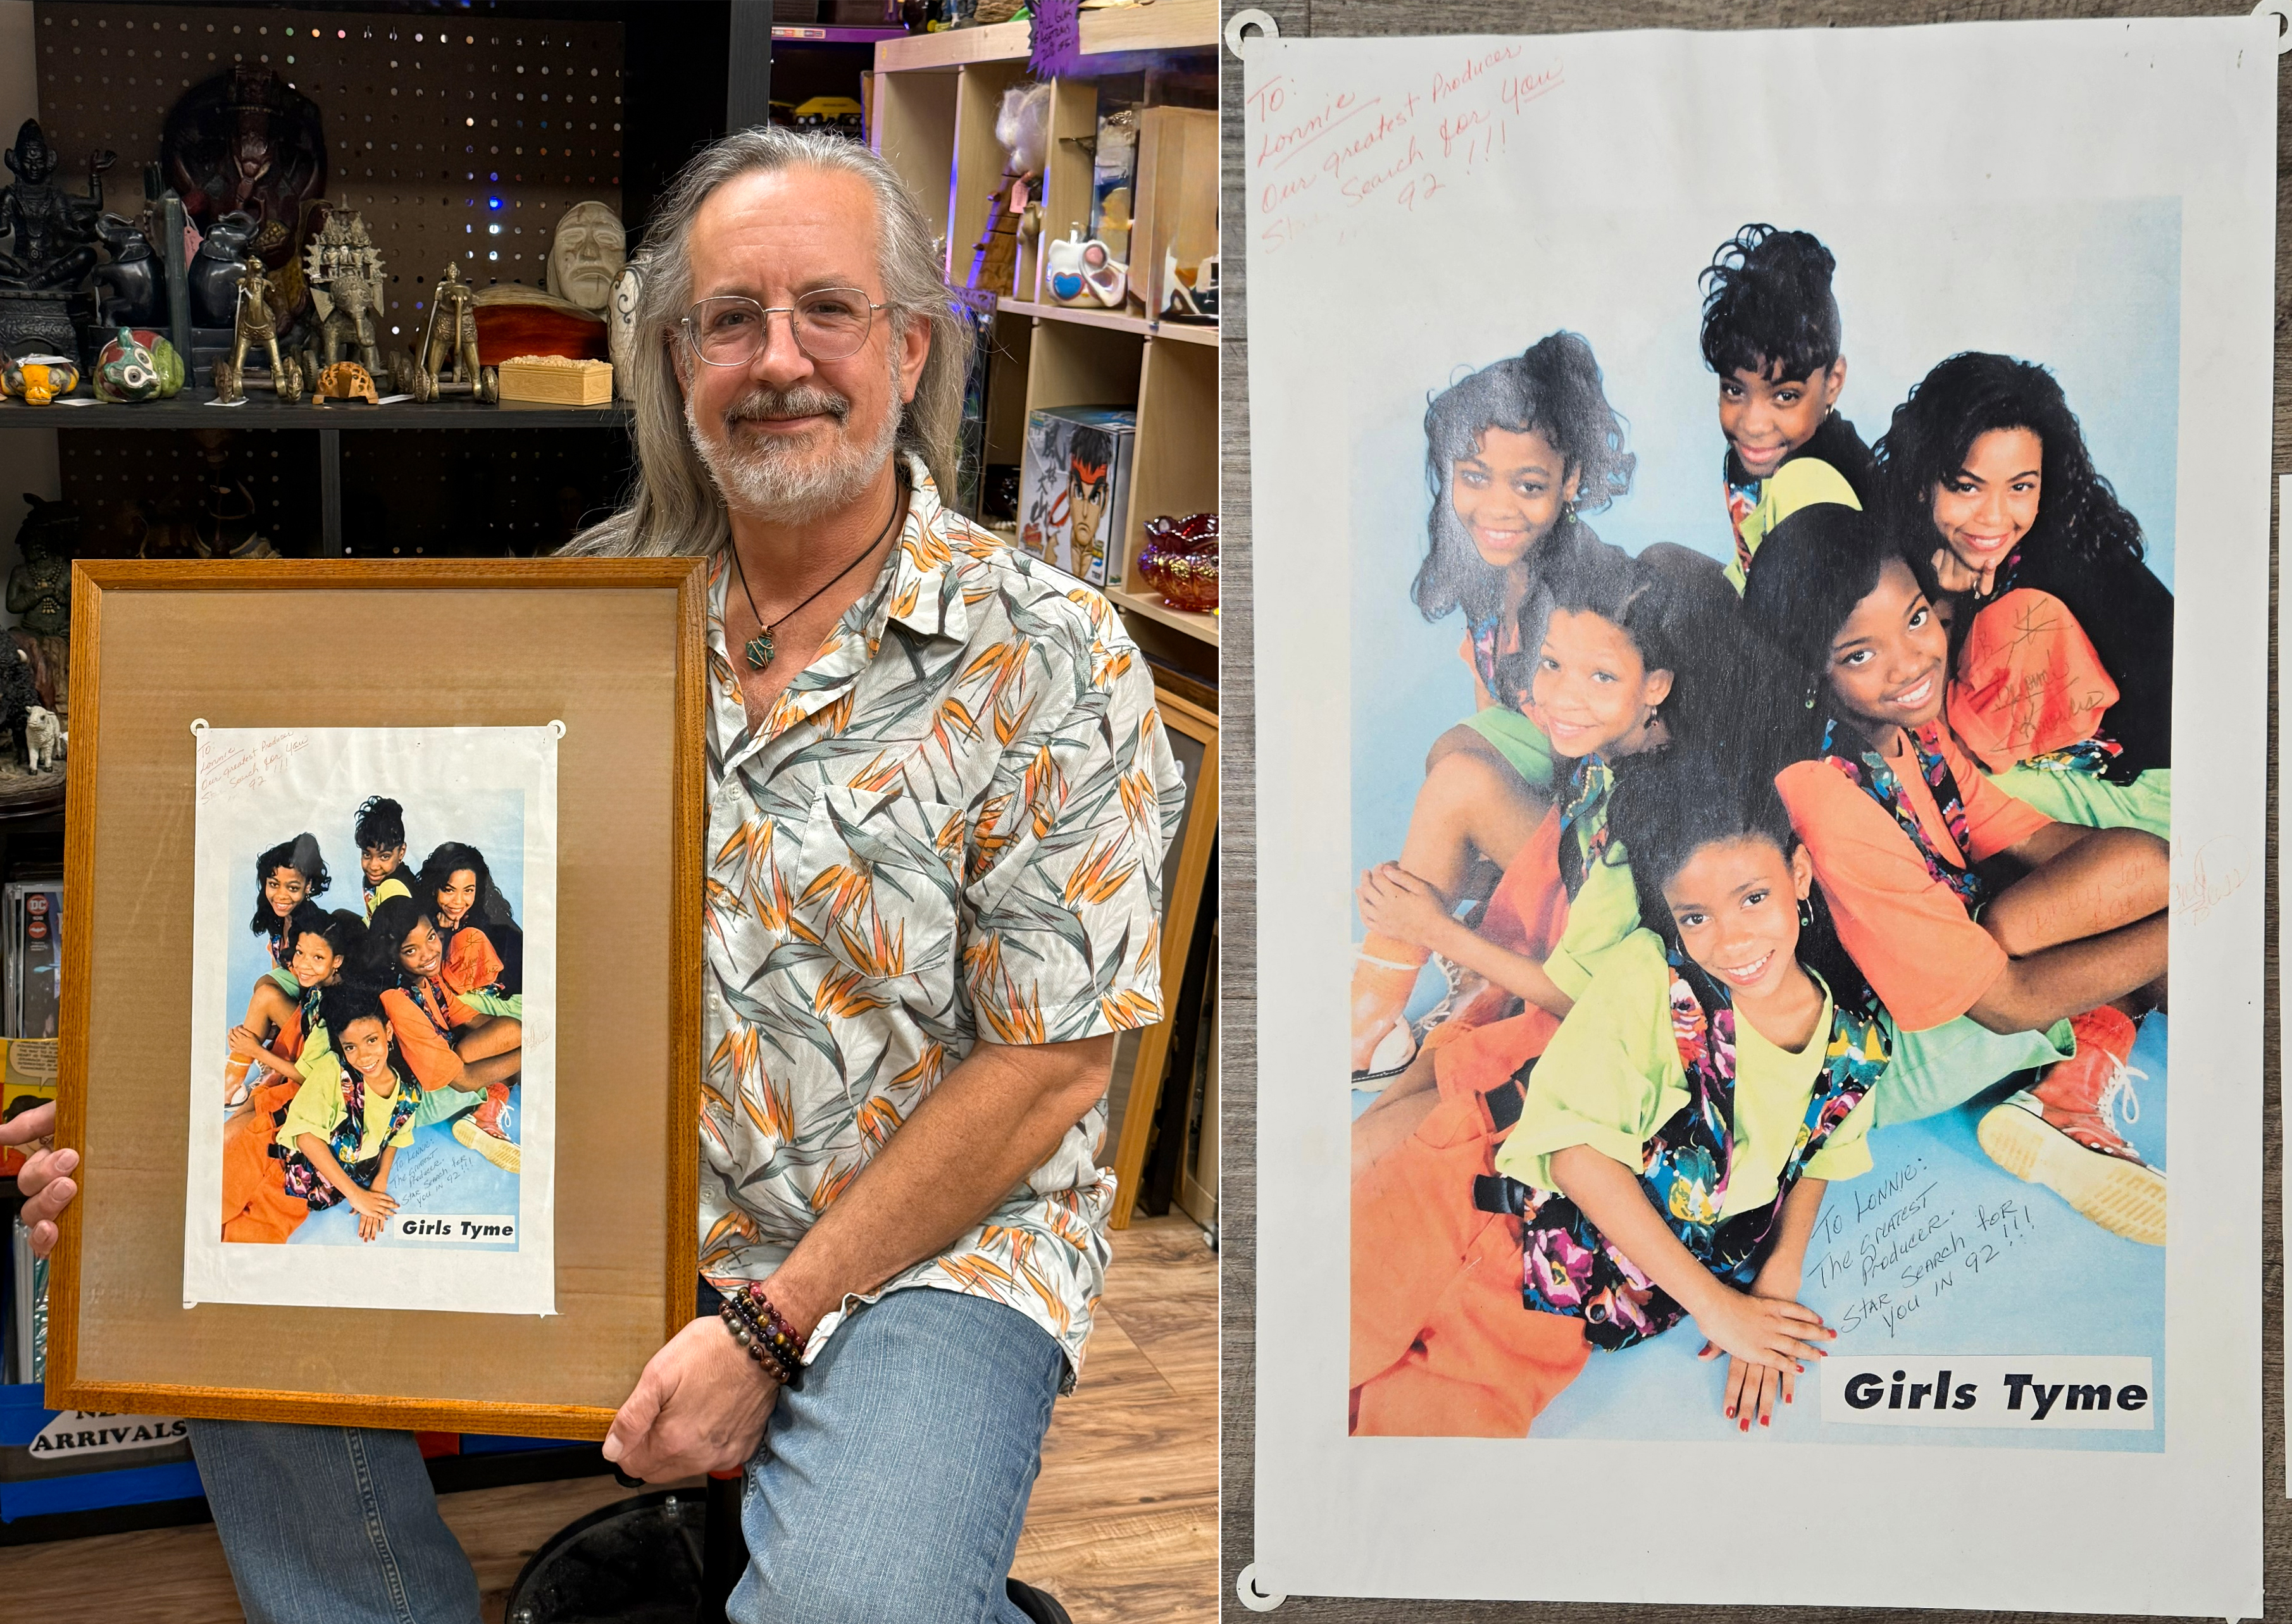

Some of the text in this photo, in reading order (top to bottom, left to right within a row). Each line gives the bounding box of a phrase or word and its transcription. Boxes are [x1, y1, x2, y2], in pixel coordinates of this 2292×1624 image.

[1257, 91, 1356, 168] Lonnie
[1262, 45, 1522, 214] Our greatest Producer
[1342, 135, 1424, 208] Search
[1439, 110, 1491, 158] for
[1397, 173, 1446, 213] 92
[201, 747, 235, 774] Lonnie
[201, 731, 294, 791] Our greatest Producer
[229, 763, 259, 788] Search
[264, 754, 282, 771] for
[30, 900, 46, 910] DC
[402, 1219, 514, 1240] Girls Tyme
[1843, 1369, 2149, 1421] Girls Tyme
[32, 1420, 187, 1451] ARRIVALS
